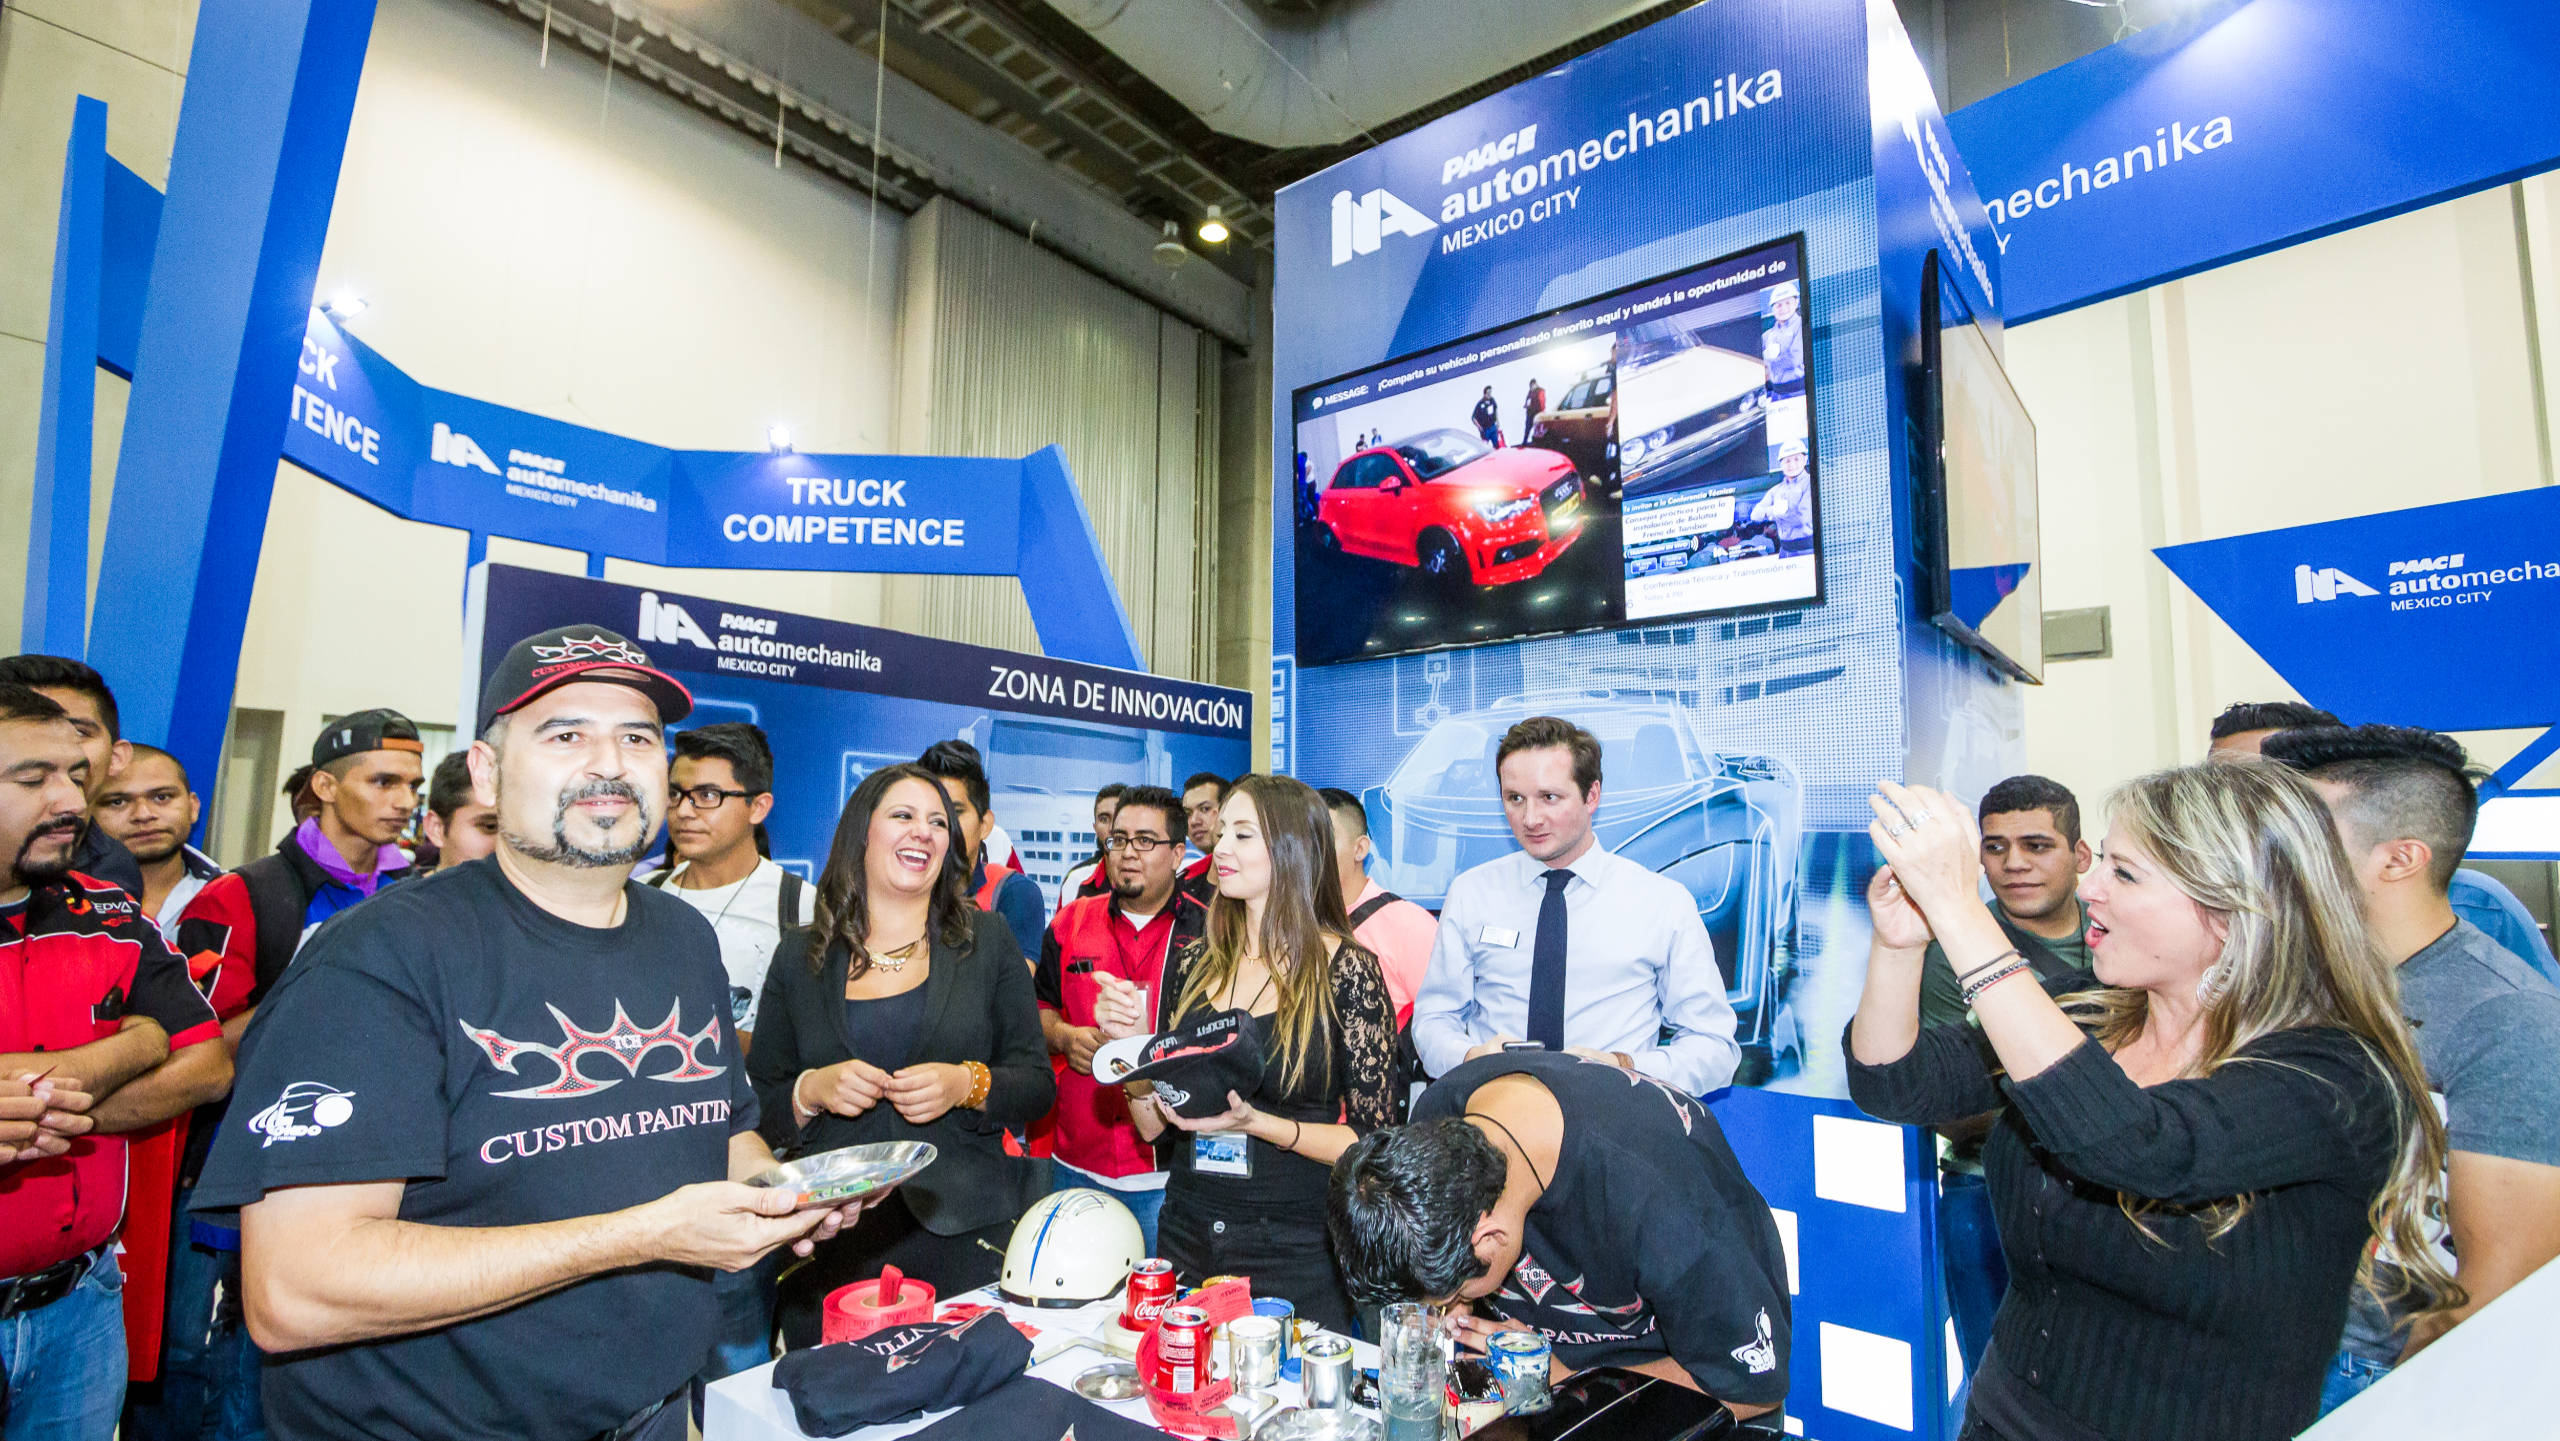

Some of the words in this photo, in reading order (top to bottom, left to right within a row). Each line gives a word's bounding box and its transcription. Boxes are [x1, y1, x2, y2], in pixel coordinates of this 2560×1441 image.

[1440, 68, 1784, 224] automechanika
[1441, 123, 1538, 185] PAACE
[1442, 208, 1525, 255] MEXICO
[1530, 187, 1582, 223] CITY
[1324, 385, 1369, 405] MESSAGE:
[1425, 364, 1437, 376] su
[1479, 331, 1551, 362] personalizado
[1552, 318, 1594, 338] favorito
[1595, 306, 1621, 328] aquí
[1621, 307, 1631, 321] y
[1673, 290, 1685, 304] la
[1687, 263, 1766, 299] oportunidad
[1768, 259, 1787, 275] de
[506, 466, 657, 512] automechanika
[506, 483, 551, 505] MEXICO
[552, 492, 578, 508] CITY
[786, 477, 907, 507] TRUCK
[723, 513, 965, 546] COMPETENCE
[2388, 553, 2464, 576] PAACE
[2391, 595, 2452, 612] MEXICO
[2456, 590, 2492, 606] CITY
[719, 613, 778, 636] PAACE
[717, 656, 767, 675] MEXICO
[769, 661, 797, 678] CITY
[718, 634, 882, 673] automechanika
[989, 666, 1066, 706] ZONA
[1074, 679, 1105, 711] DE
[1111, 685, 1242, 729] INNOVACIÓN
[480, 1112, 634, 1164] CUSTOM
